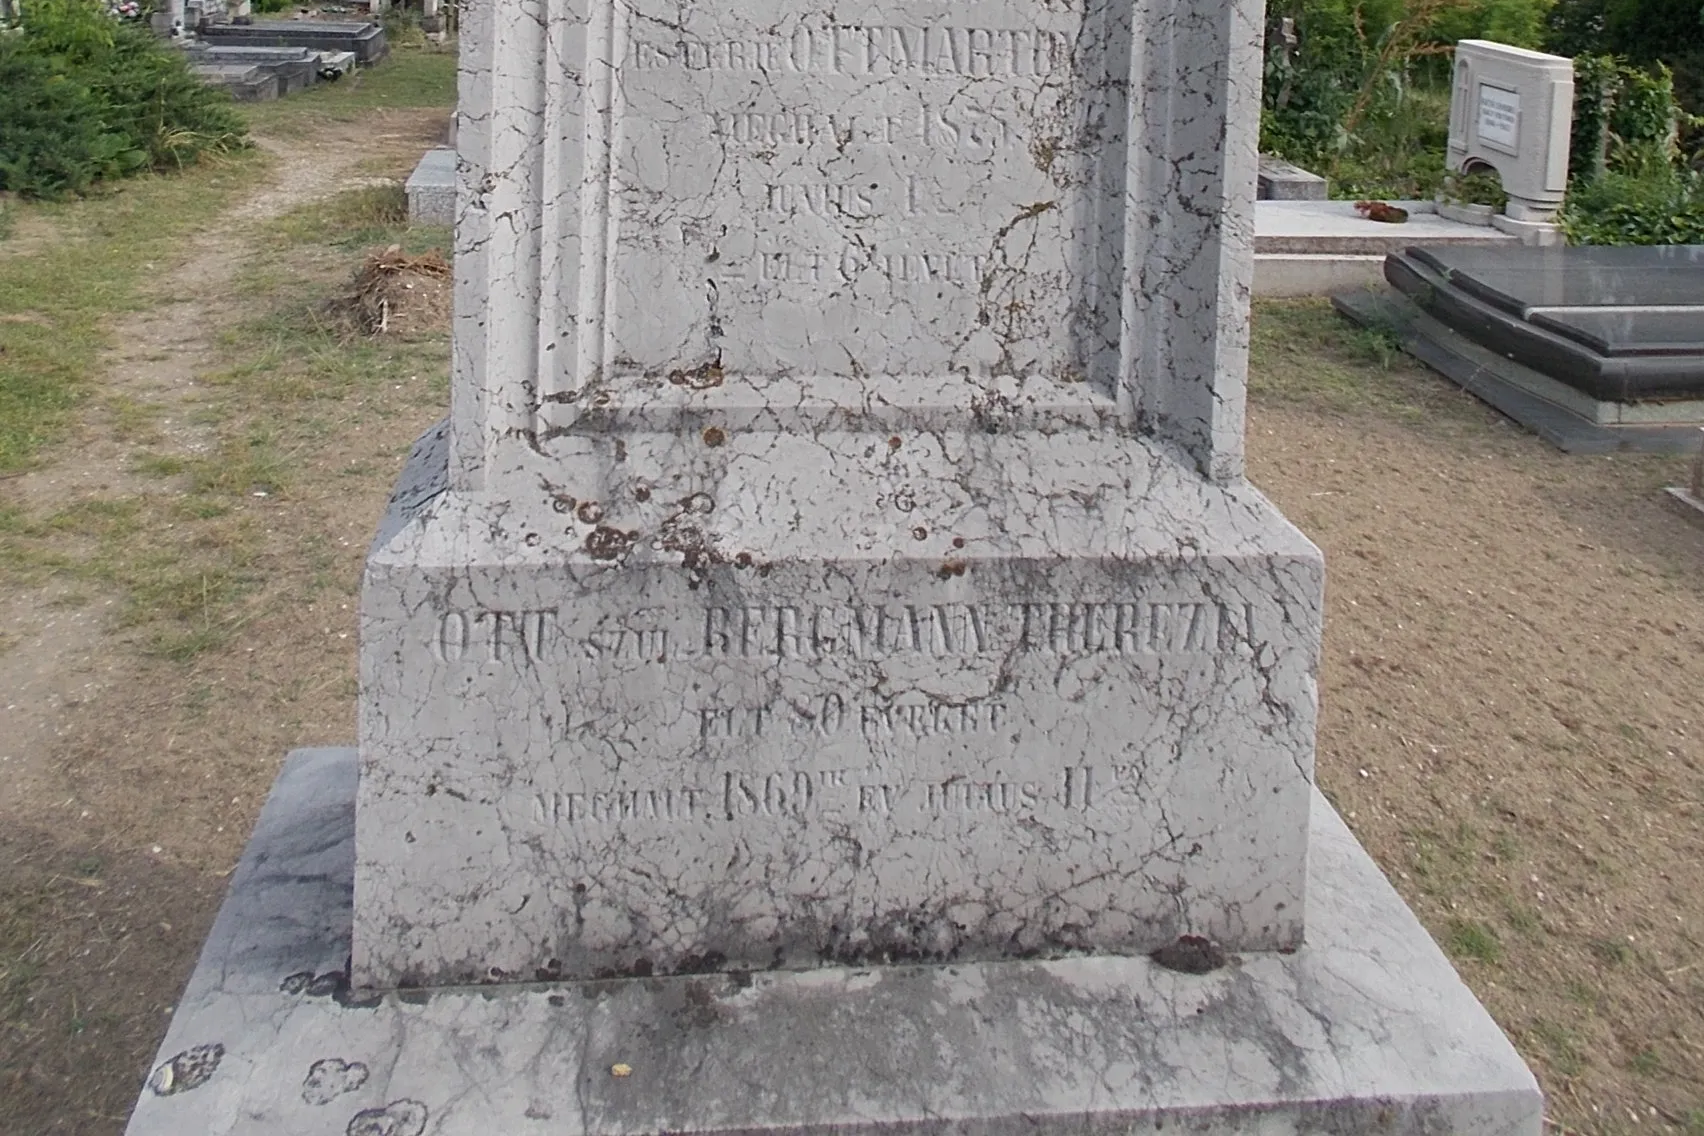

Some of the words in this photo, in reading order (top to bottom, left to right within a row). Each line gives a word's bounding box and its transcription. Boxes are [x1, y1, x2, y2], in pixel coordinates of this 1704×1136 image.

[704, 112, 902, 146] MEGHALT
[436, 608, 560, 664] OTT
[704, 604, 992, 659] BERGMANN
[533, 788, 706, 822] MEGHALT
